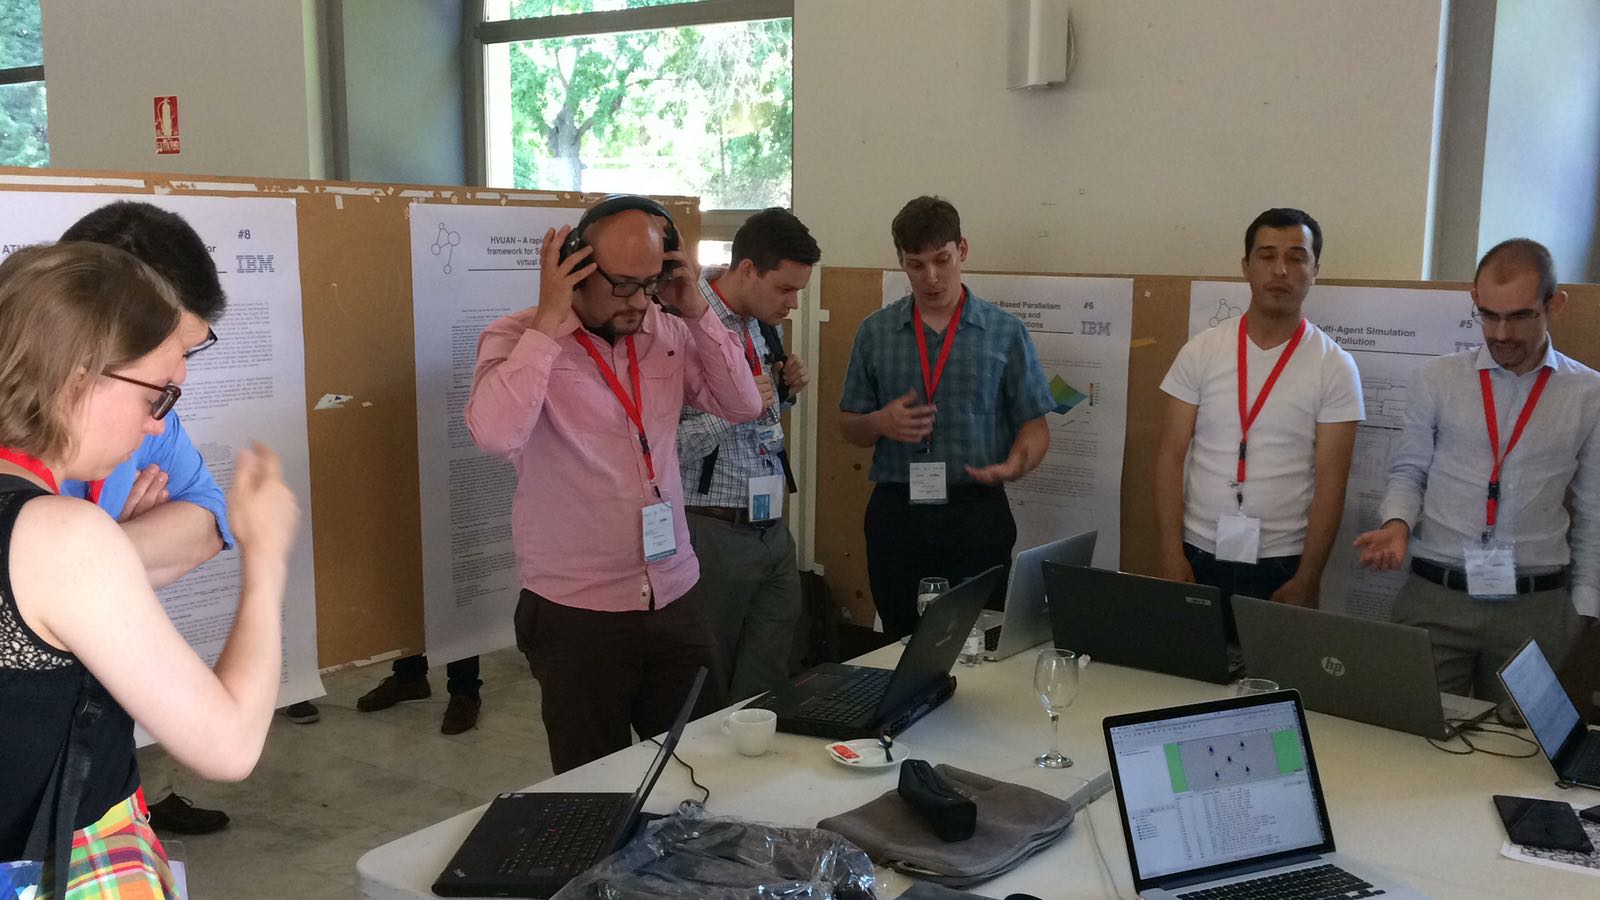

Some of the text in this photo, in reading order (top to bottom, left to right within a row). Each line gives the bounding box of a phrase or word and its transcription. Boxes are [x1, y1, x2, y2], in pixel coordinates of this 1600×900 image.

[237, 229, 251, 240] #8
[490, 236, 516, 244] HVUAN
[522, 236, 528, 244] A
[487, 247, 523, 255] framework
[524, 247, 534, 255] for
[235, 254, 275, 273] IBM
[516, 258, 538, 266] virtual
[1022, 301, 1061, 310] Parallelism
[1083, 301, 1094, 310] #6
[1028, 311, 1041, 319] and
[1080, 320, 1111, 336] IBM
[1459, 319, 1473, 329] #5
[1366, 326, 1416, 337] Simulation
[1335, 336, 1376, 346] Pollution
[1321, 656, 1346, 677] hp
